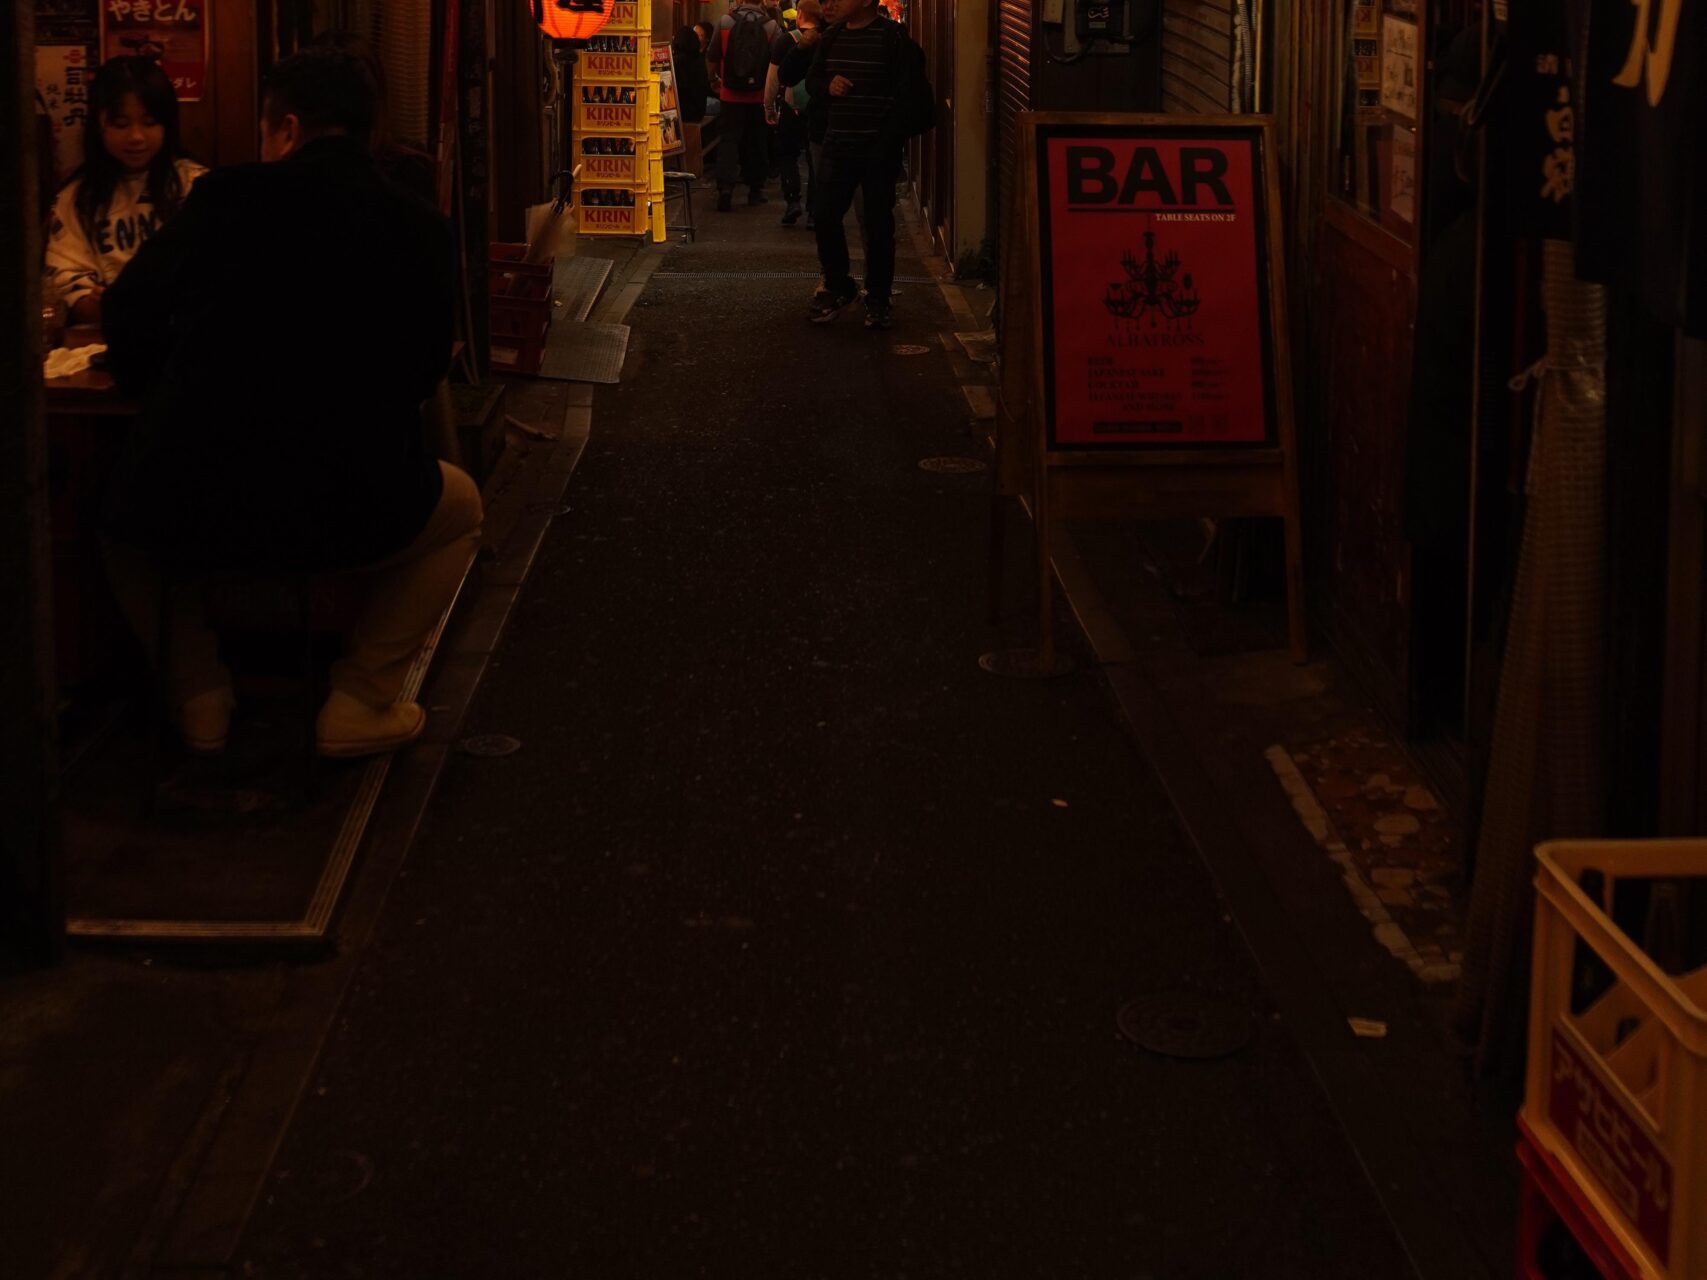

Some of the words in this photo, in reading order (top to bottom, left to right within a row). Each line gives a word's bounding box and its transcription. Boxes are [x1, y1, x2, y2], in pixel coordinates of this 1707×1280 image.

[108, 0, 197, 23] やきとん
[587, 55, 633, 69] KIRIN
[585, 107, 632, 121] KIRIN
[585, 159, 631, 173] KIRIN
[1066, 145, 1234, 206] BAR
[584, 210, 631, 223] KIRIN
[1106, 333, 1205, 347] ALBATROSS
